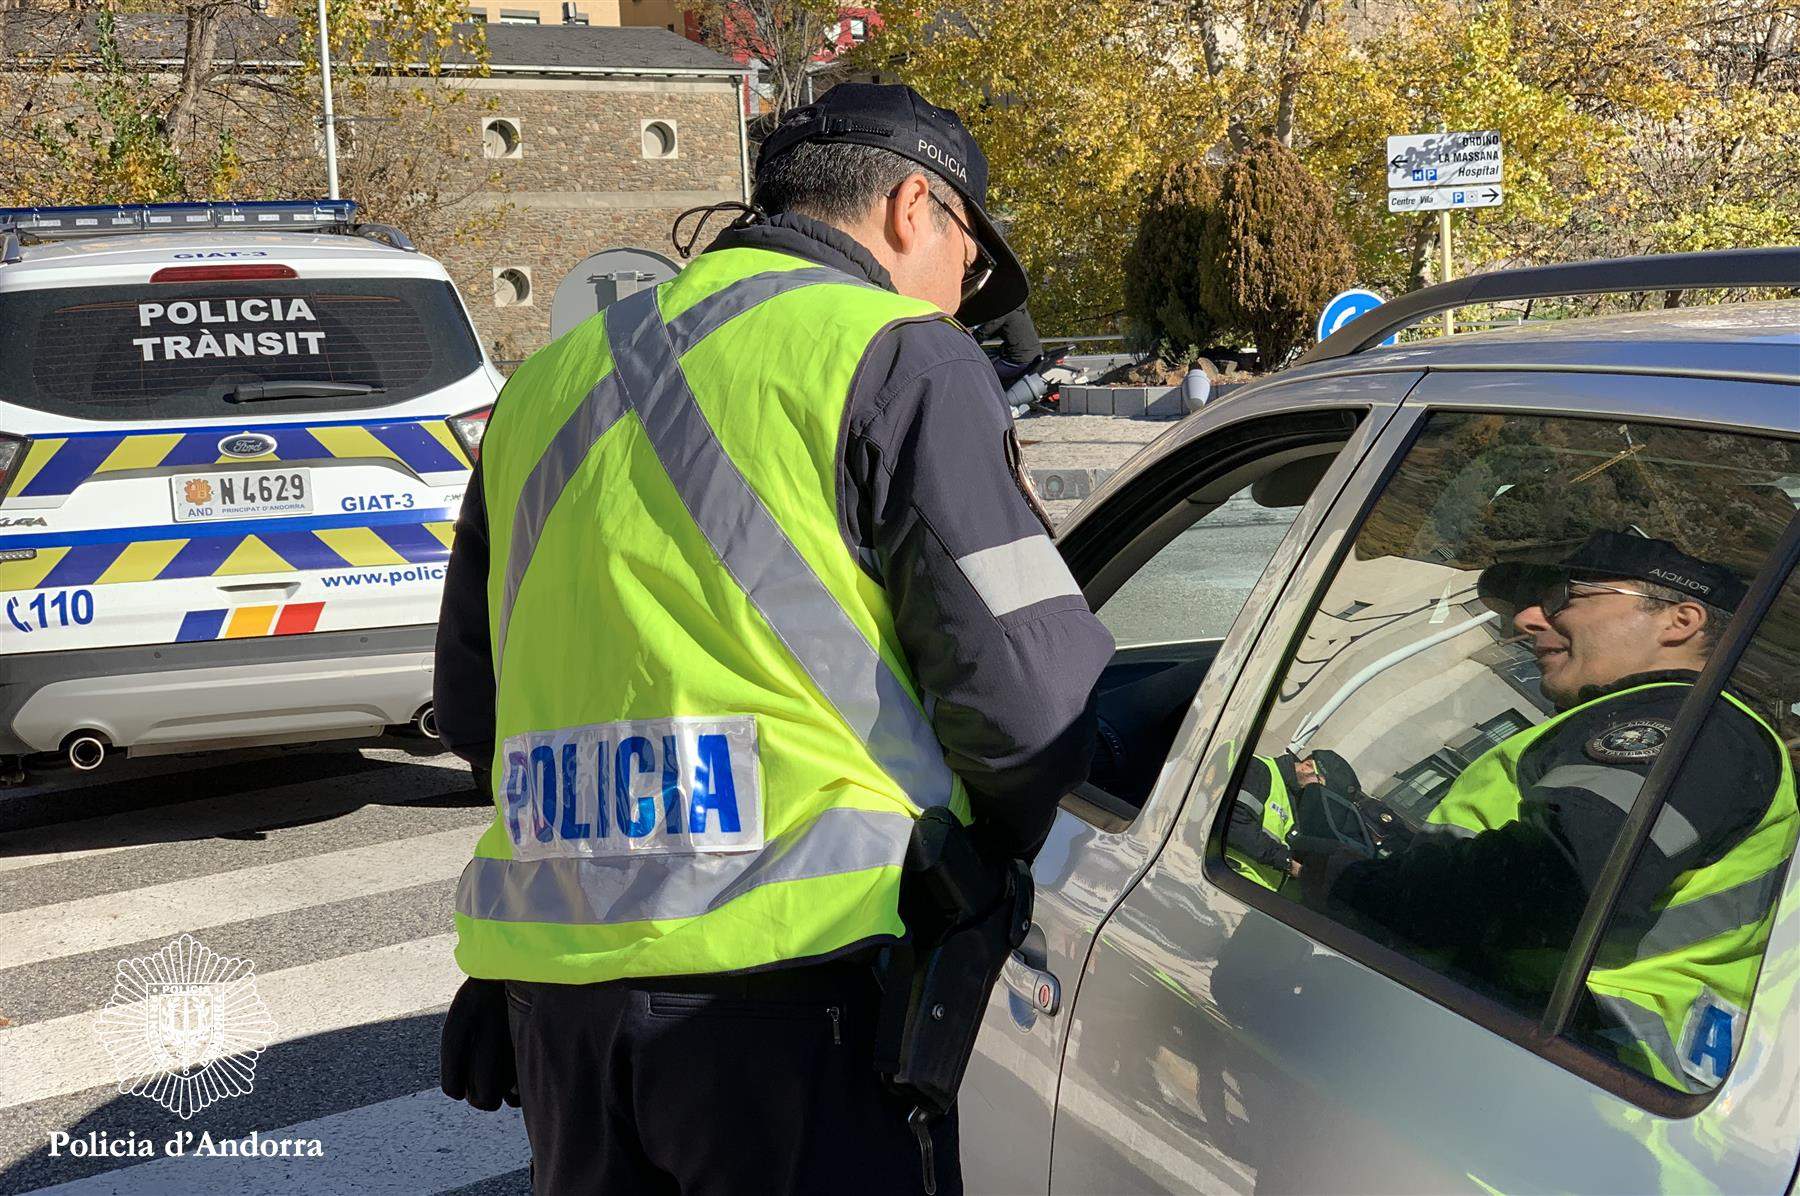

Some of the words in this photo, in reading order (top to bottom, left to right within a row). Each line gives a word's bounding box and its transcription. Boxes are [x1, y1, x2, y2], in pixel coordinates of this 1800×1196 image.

[1462, 135, 1499, 147] ORDINO
[918, 139, 967, 184] POLICIA
[1438, 153, 1450, 163] LA
[1453, 151, 1499, 161] MASSANA
[1458, 165, 1499, 178] Hospital
[1391, 197, 1416, 206] Centre
[1420, 195, 1434, 204] Vila
[174, 251, 268, 259] GIAT-3
[138, 298, 316, 327] POLICIA
[133, 328, 326, 362] TRÀNSIT
[233, 439, 262, 453] Ford
[219, 478, 235, 505] N
[243, 473, 305, 503] 4629
[188, 507, 213, 518] AND
[222, 506, 260, 514] PRINCIPAT
[263, 503, 305, 511] D'ANDORRA
[341, 493, 414, 512] GIAT-3
[29, 589, 94, 629] 110
[507, 734, 742, 845] POLICIA
